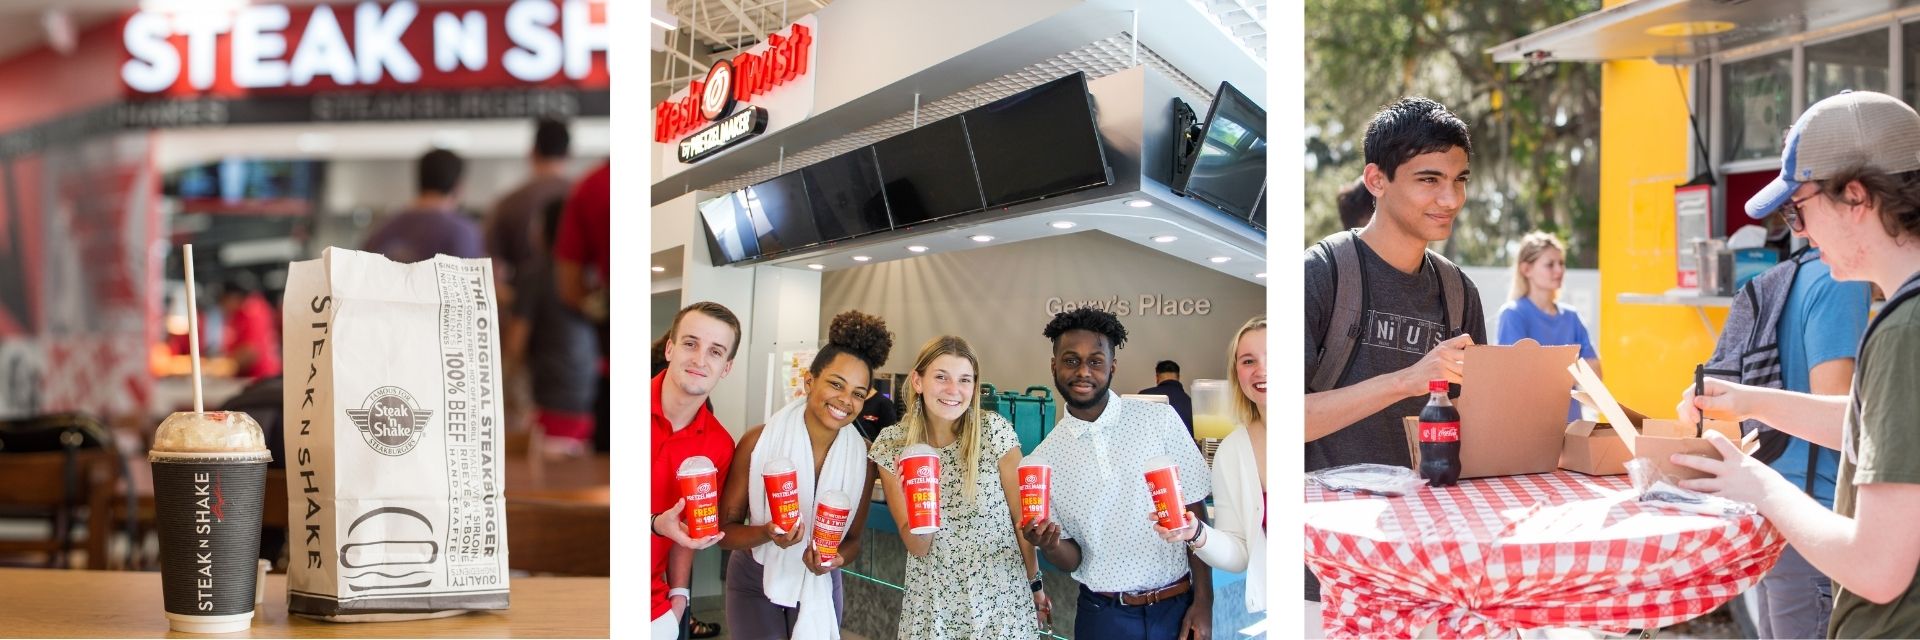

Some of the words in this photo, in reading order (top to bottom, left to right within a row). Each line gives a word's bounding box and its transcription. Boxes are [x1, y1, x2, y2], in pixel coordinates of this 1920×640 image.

[121, 1, 421, 93] STEAK
[433, 11, 488, 71] N
[733, 23, 812, 102] Twist
[690, 110, 752, 158] PRETZELMAKER
[443, 286, 451, 345] PRESERVATIVES
[470, 277, 488, 312] THE
[1139, 293, 1211, 316] Place
[301, 295, 332, 410] STEAK
[445, 351, 466, 395] 100%
[467, 339, 475, 363] FRESH
[476, 317, 491, 410] ORIGINAL
[370, 388, 397, 401] FAMOUS
[374, 401, 409, 417] Steak
[300, 419, 311, 436] N
[373, 421, 411, 437] Shake
[448, 400, 466, 443] BEEF
[368, 438, 416, 455] STEAKBURGERS
[460, 448, 472, 497] RIBEYE
[481, 416, 496, 558] STEAKBURGER
[194, 472, 211, 535] SHAKE
[298, 447, 322, 570] SHAKE
[449, 448, 460, 562] HAND-CRAFTED
[199, 539, 209, 548] N
[461, 513, 472, 563] T-BONE
[197, 552, 213, 612] STEAK
[452, 575, 497, 586] QUALITY
